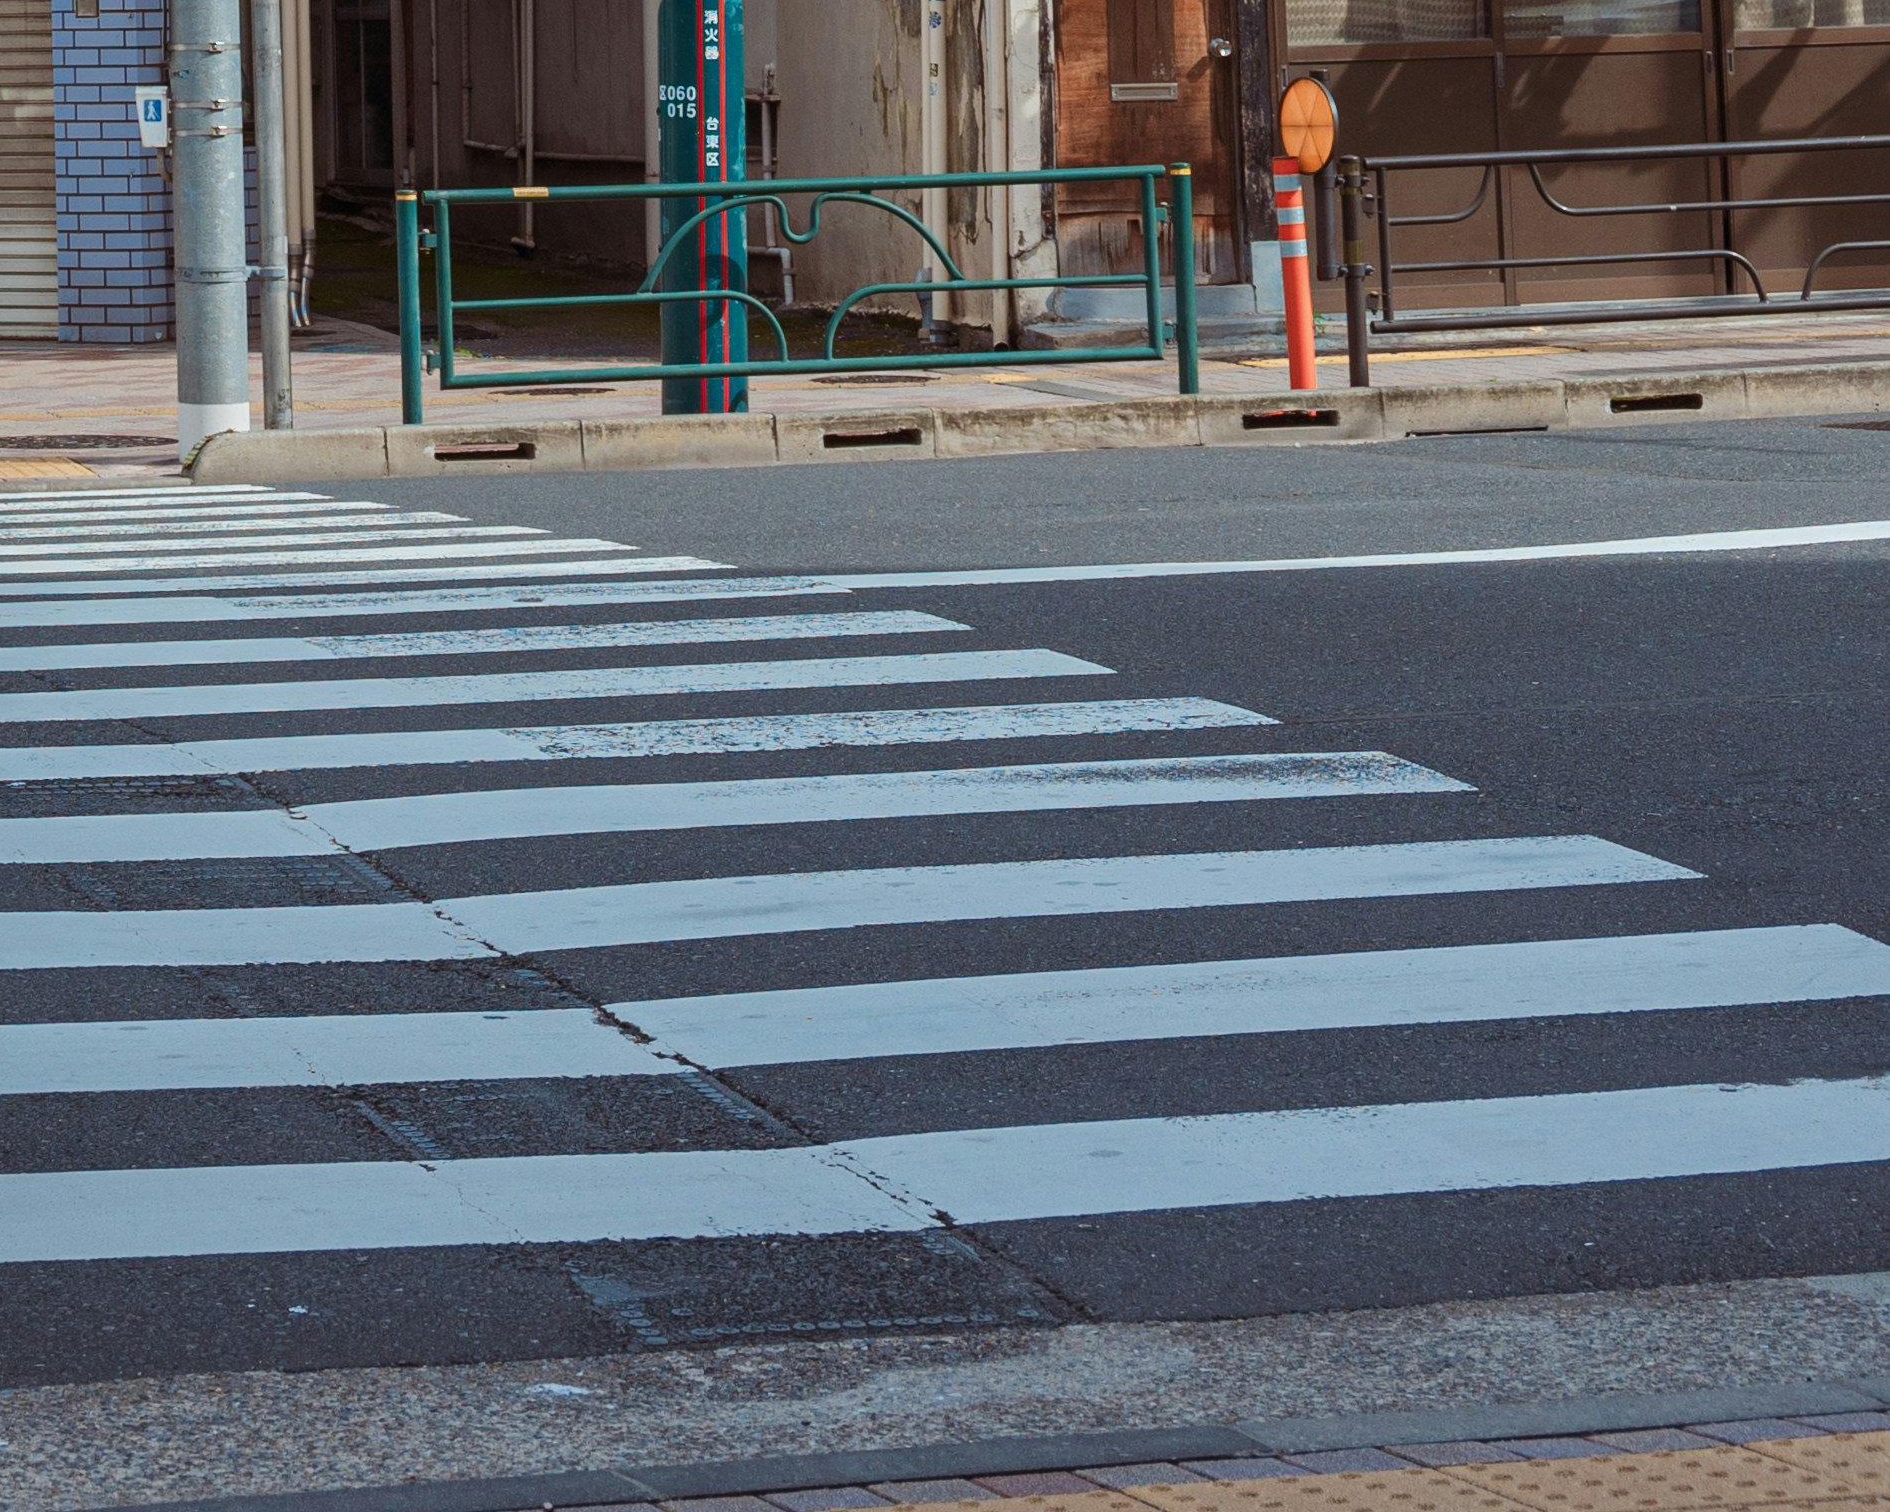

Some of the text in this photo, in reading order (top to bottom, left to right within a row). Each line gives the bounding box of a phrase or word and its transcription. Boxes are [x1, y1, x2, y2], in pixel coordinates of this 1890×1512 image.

[704, 10, 719, 60] 消火器
[667, 103, 697, 118] 015
[706, 116, 719, 166] 台東区
